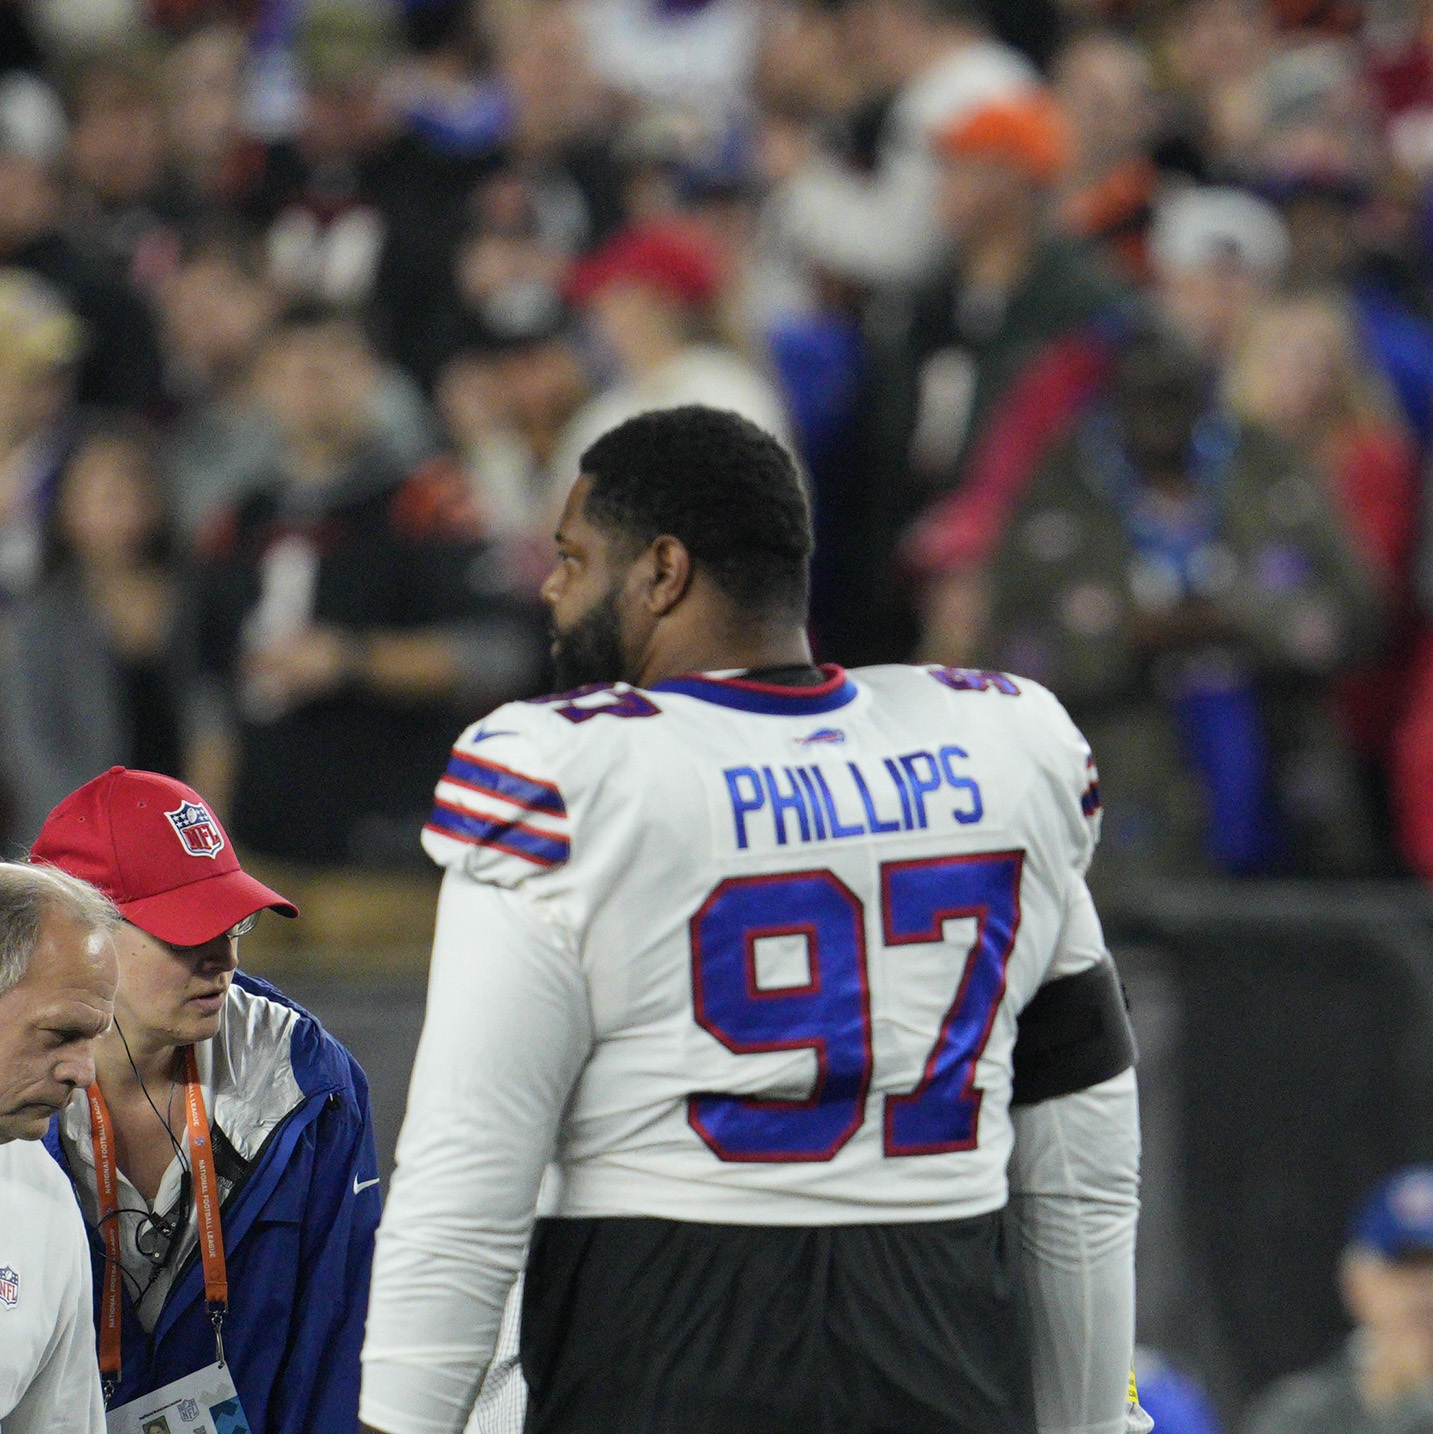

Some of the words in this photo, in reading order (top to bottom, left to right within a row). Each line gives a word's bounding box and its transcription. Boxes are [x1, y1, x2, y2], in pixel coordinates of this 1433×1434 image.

[723, 744, 985, 850] PHILLIPS
[181, 822, 221, 851] NFL
[688, 848, 1027, 1163] 97
[90, 1096, 105, 1125] LEAGUE
[95, 1125, 109, 1158] FOOTBALL
[98, 1158, 111, 1194] NATIONAL
[199, 1158, 209, 1192] NATIONAL
[201, 1192, 213, 1228] FOOTBALL
[206, 1228, 217, 1258] LEAGUE
[0, 1280, 17, 1302] NFL
[108, 1296, 116, 1329] NATIONAL
